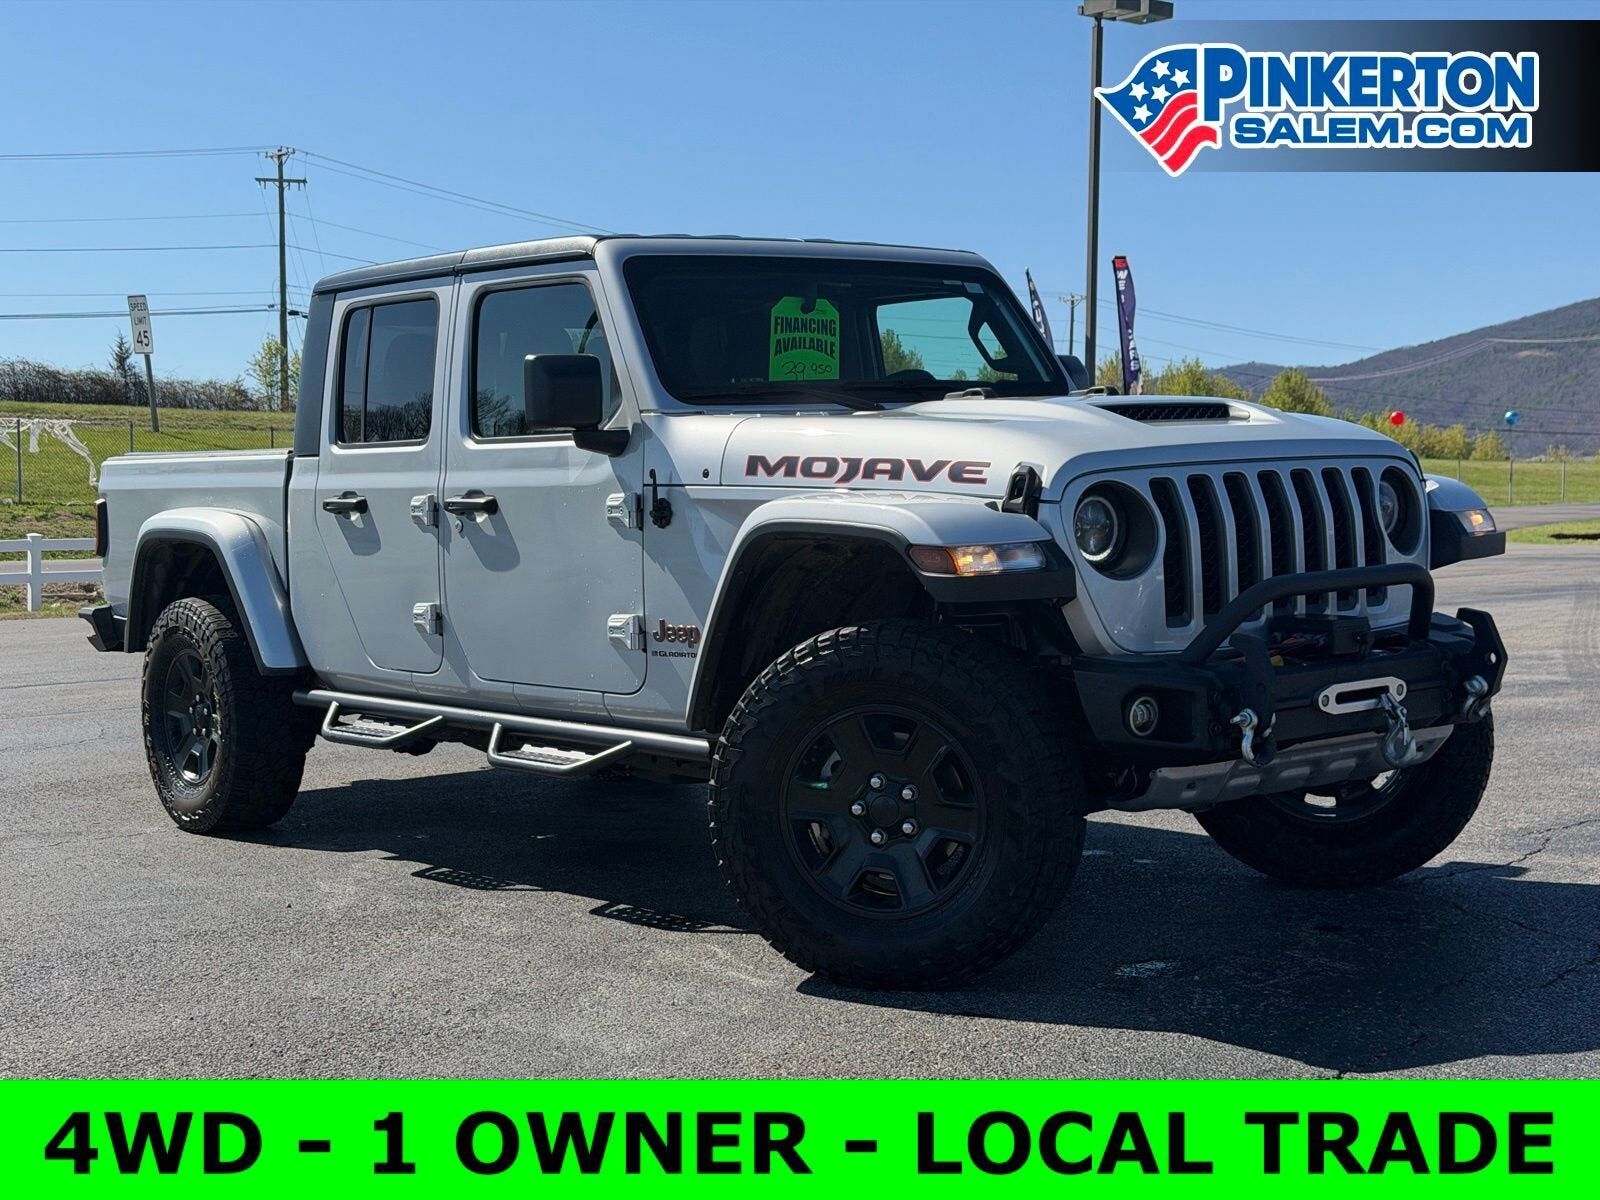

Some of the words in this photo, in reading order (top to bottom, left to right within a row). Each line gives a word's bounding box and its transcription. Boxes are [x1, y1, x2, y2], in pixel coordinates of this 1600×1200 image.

[130, 302, 147, 311] SPEED
[134, 316, 147, 326] LIMIT
[773, 315, 837, 338] FINANCING
[136, 330, 150, 347] 45
[773, 336, 836, 360] AVAILABLE
[744, 455, 992, 485] MOJAVE
[652, 618, 701, 649] Jeep
[658, 650, 698, 659] GLADIATO
